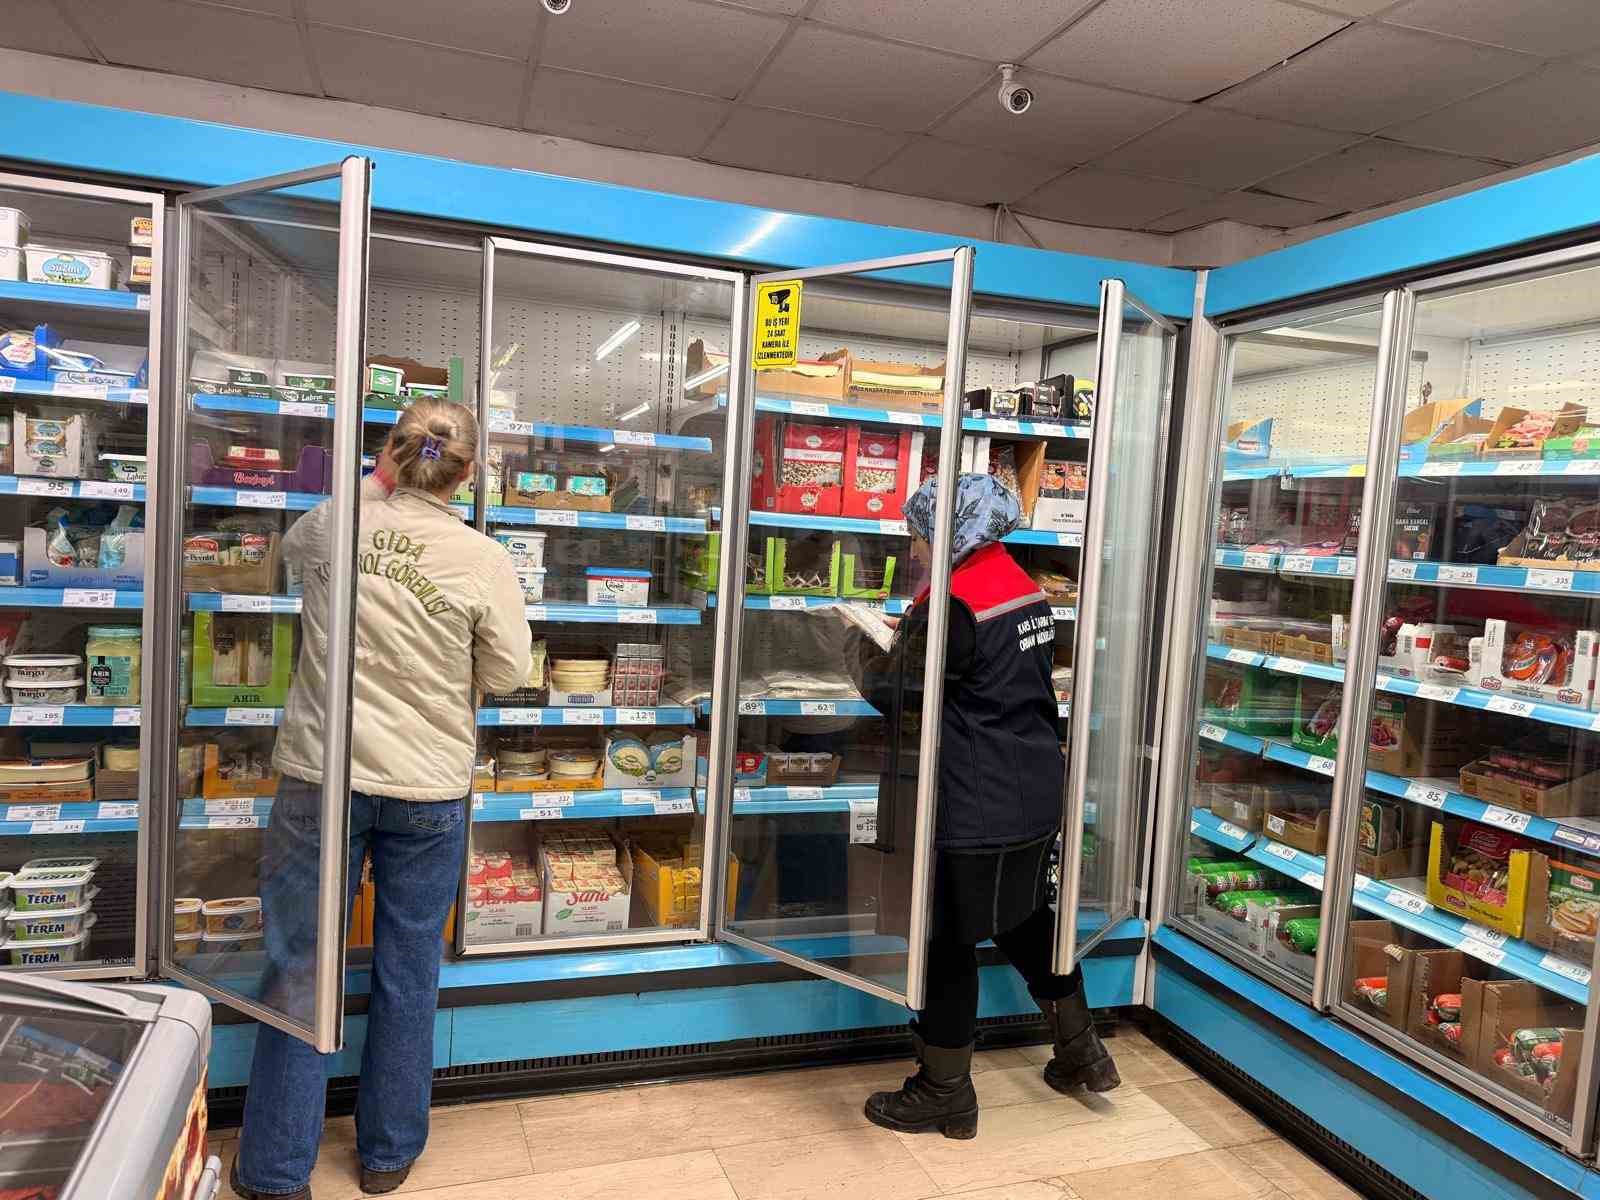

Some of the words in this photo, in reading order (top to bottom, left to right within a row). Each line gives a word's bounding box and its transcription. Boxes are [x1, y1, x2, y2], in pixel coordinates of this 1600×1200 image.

[47, 481, 65, 491] 95
[372, 529, 426, 562] GIDA
[745, 703, 757, 711] 89
[817, 703, 829, 711] 62
[1510, 702, 1523, 711] 59
[1427, 791, 1439, 801] 85
[236, 816, 250, 824] 29
[1504, 813, 1518, 824] 76
[27, 894, 66, 905] TEREM
[26, 923, 65, 934] TEREM
[21, 953, 60, 964] TEREM
